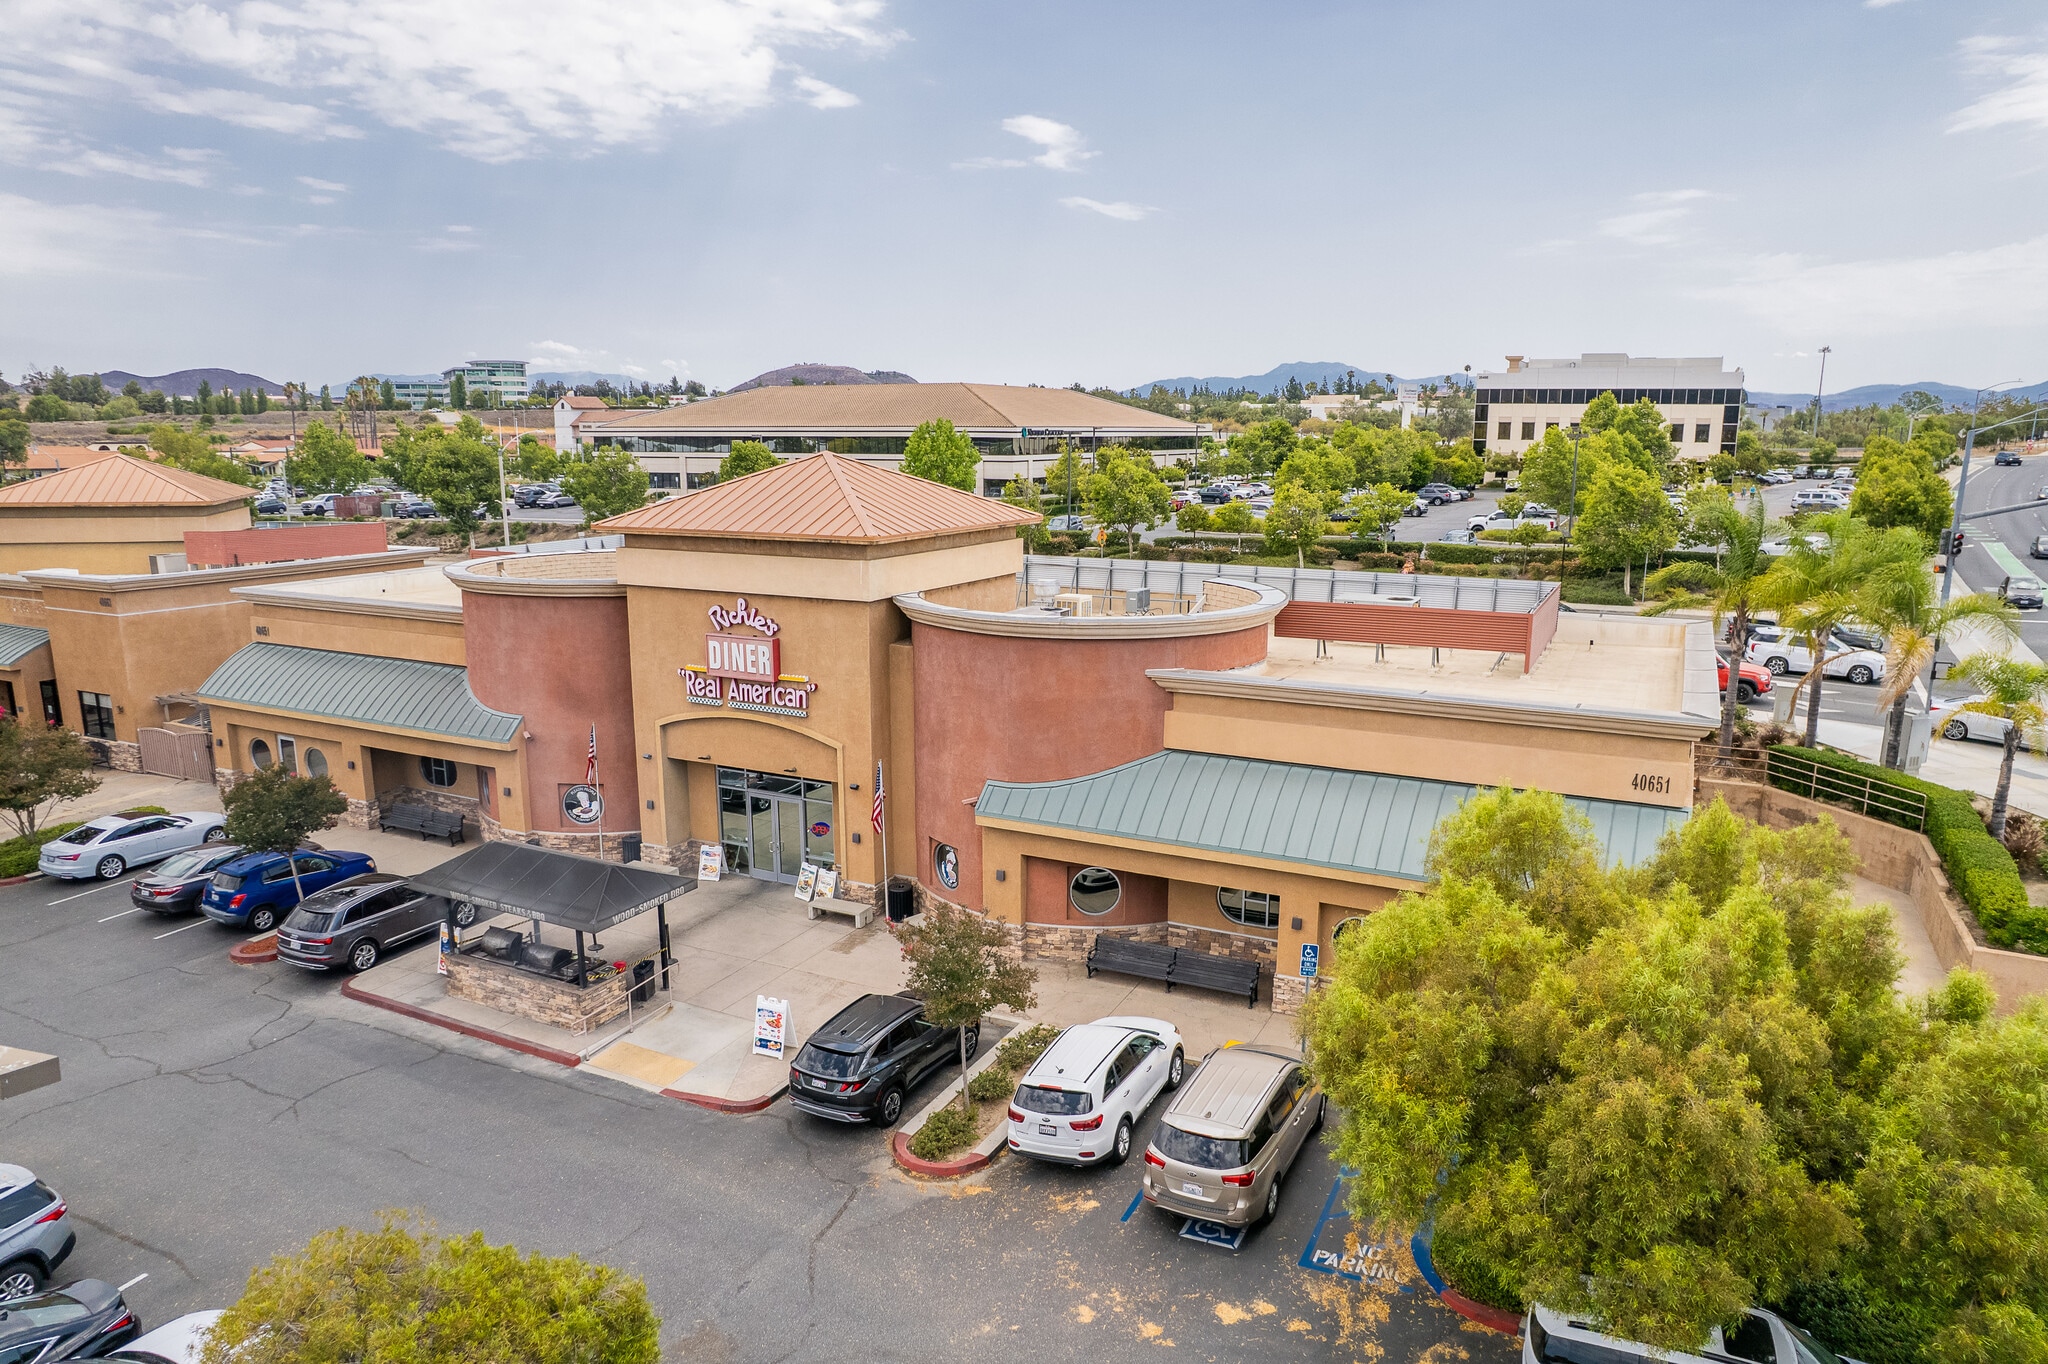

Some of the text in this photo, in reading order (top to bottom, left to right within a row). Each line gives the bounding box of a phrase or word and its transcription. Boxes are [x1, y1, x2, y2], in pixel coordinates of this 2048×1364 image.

[708, 640, 771, 675] DINER
[1631, 773, 1671, 793] 40651
[811, 824, 829, 834] OPEN
[500, 903, 525, 917] STEAKS
